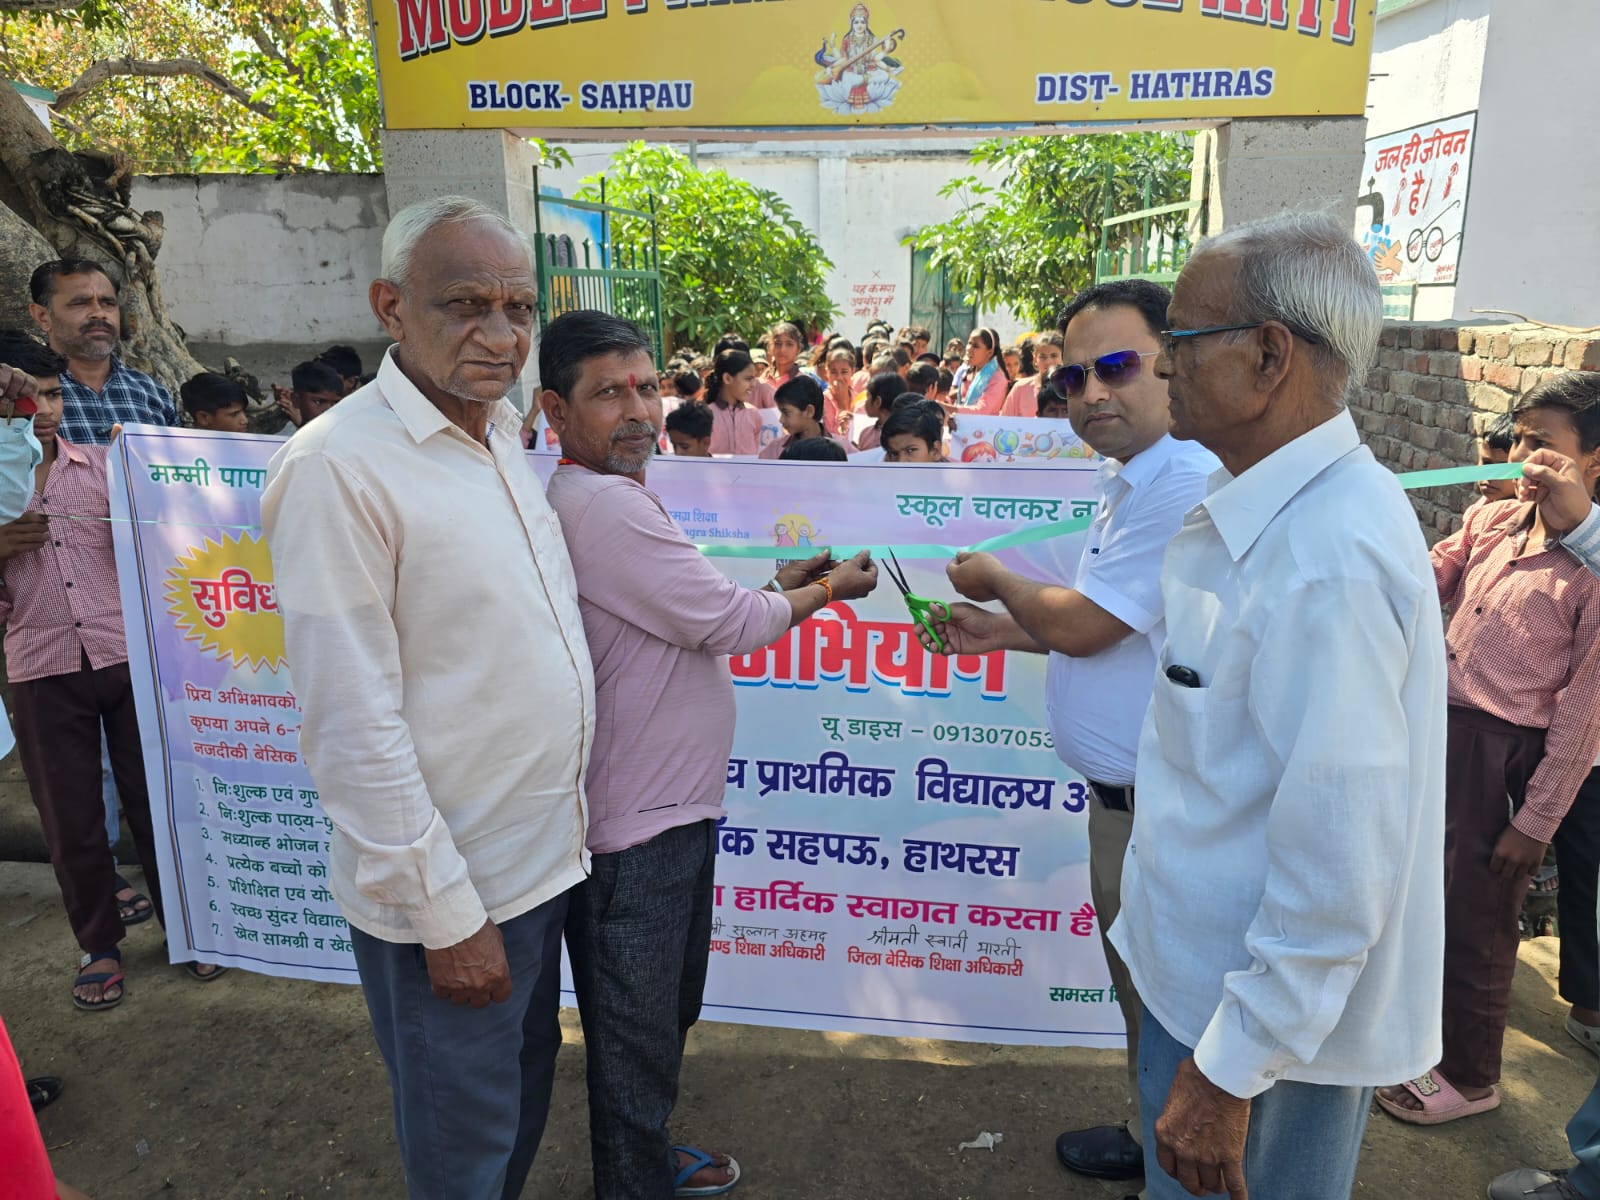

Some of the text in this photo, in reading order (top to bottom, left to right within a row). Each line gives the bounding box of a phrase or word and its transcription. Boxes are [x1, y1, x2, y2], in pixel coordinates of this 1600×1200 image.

[469, 82, 693, 109] BLOCK- SAHPAU
[1036, 70, 1274, 102] DIST- HATHRAS
[148, 457, 210, 487] मम्मी
[896, 494, 963, 527] स्कूल
[972, 496, 1062, 522] चलकर
[708, 527, 750, 539] Shiksha
[185, 682, 212, 702] प्रिय
[189, 715, 228, 733] कृपया
[234, 717, 270, 734] अपने
[821, 717, 844, 742] यू
[846, 719, 903, 741] डाइस
[933, 725, 1055, 749] 091307053
[193, 741, 298, 763] नजदीकी बेसिक
[271, 784, 294, 802] एवं
[756, 751, 895, 798] प्राथमिक
[915, 758, 1055, 811] विद्यालय
[276, 833, 320, 853] भोजन
[226, 854, 264, 873] प्रत्येक
[307, 860, 327, 878] को
[902, 838, 1021, 877] हाथरस
[228, 876, 281, 899] प्रशिक्षित
[284, 884, 306, 901] एवं
[230, 902, 262, 920] स्वच्छ
[266, 906, 298, 927] सुंदर
[303, 907, 348, 929] विद्याल
[733, 880, 838, 913] हार्दिक
[846, 894, 958, 925] स्वागत
[968, 904, 1062, 932] करता
[233, 922, 258, 942] खेल
[262, 931, 309, 949] सामग्री
[314, 938, 324, 950] व
[735, 938, 766, 956] शिक्षा
[769, 941, 826, 961] अधिकारी
[847, 946, 1023, 977] जिला बेसिक शिक्षा अधिकारी
[1049, 987, 1104, 1003] समस्त
